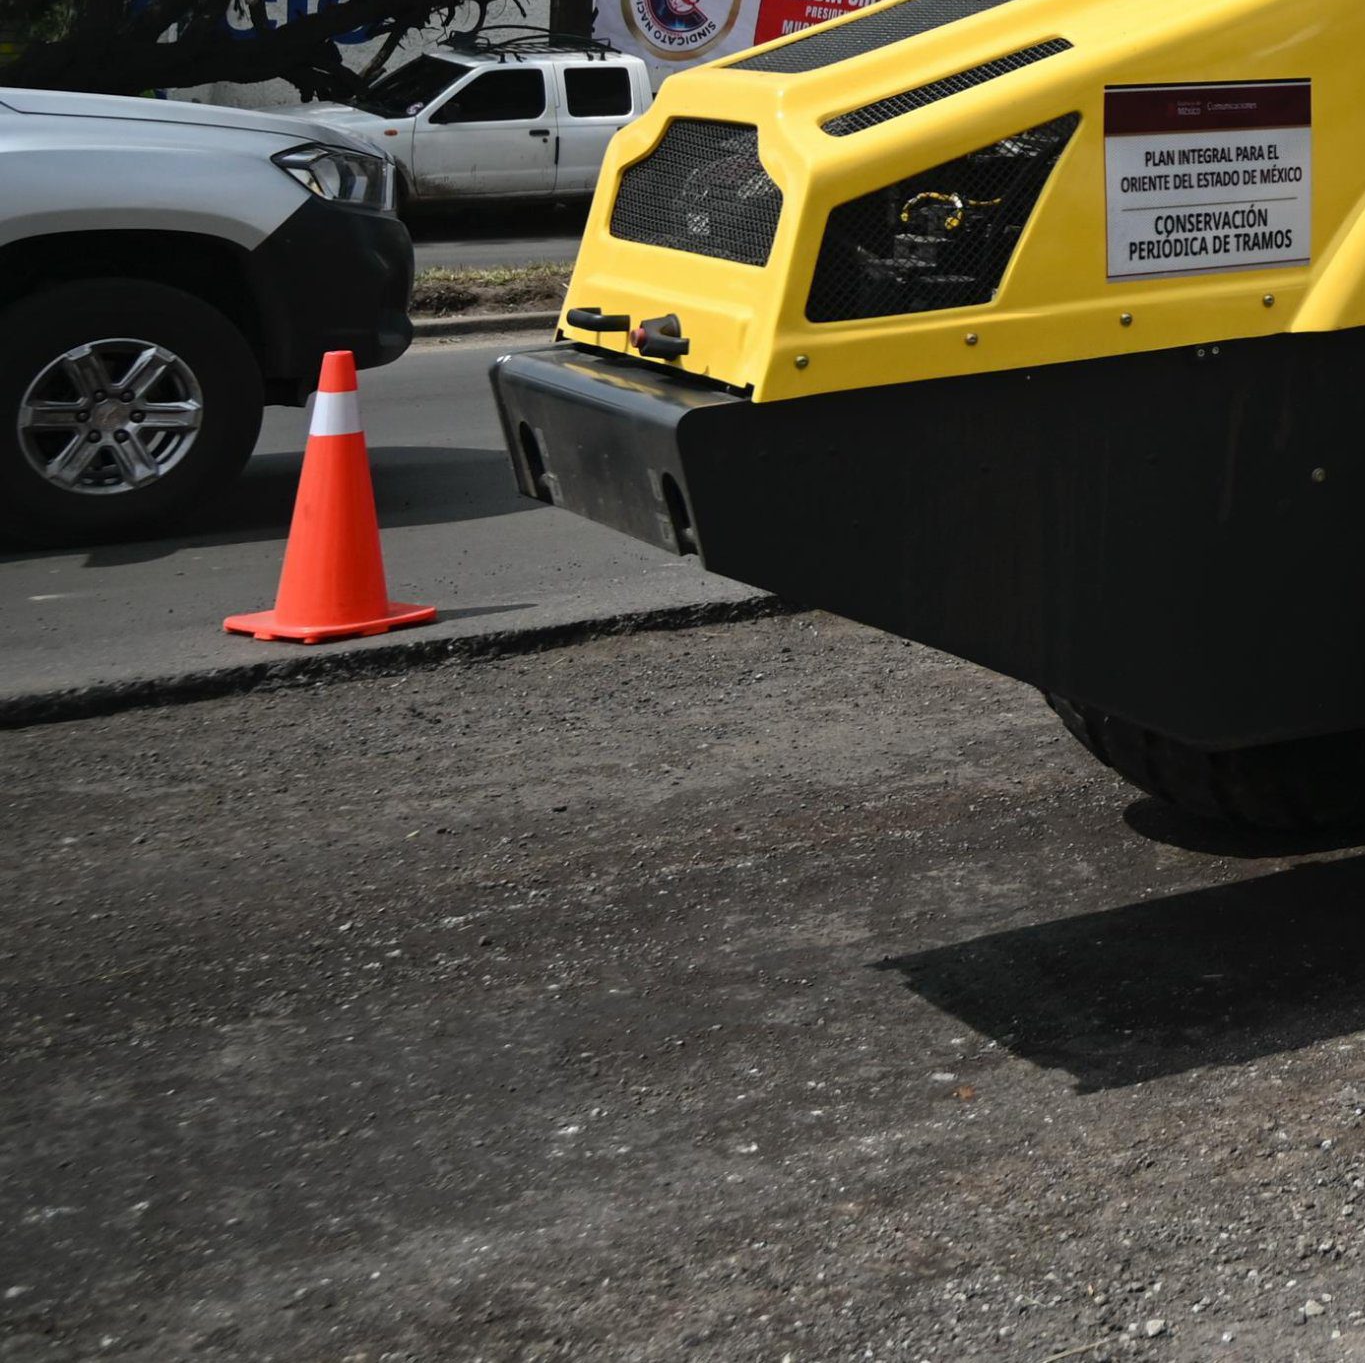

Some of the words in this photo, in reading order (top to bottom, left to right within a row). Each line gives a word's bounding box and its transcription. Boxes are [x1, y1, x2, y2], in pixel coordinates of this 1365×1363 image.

[654, 21, 718, 46] SINDICATO
[1145, 149, 1175, 167] PLAN
[1178, 146, 1233, 165] INTEGRAL
[1235, 145, 1265, 163] PARA
[1267, 144, 1279, 160] EL
[1120, 174, 1170, 193] ORIENTE
[1173, 173, 1194, 190] DEL
[1199, 170, 1240, 188] ESTADO
[1243, 169, 1256, 185] DE
[1260, 164, 1303, 185] MÉXICO
[1154, 204, 1268, 236] CONSERVACIÓN
[1128, 232, 1209, 261] PERIÓDICA
[1212, 234, 1231, 255] DE
[1234, 228, 1293, 252] TRAMOS
